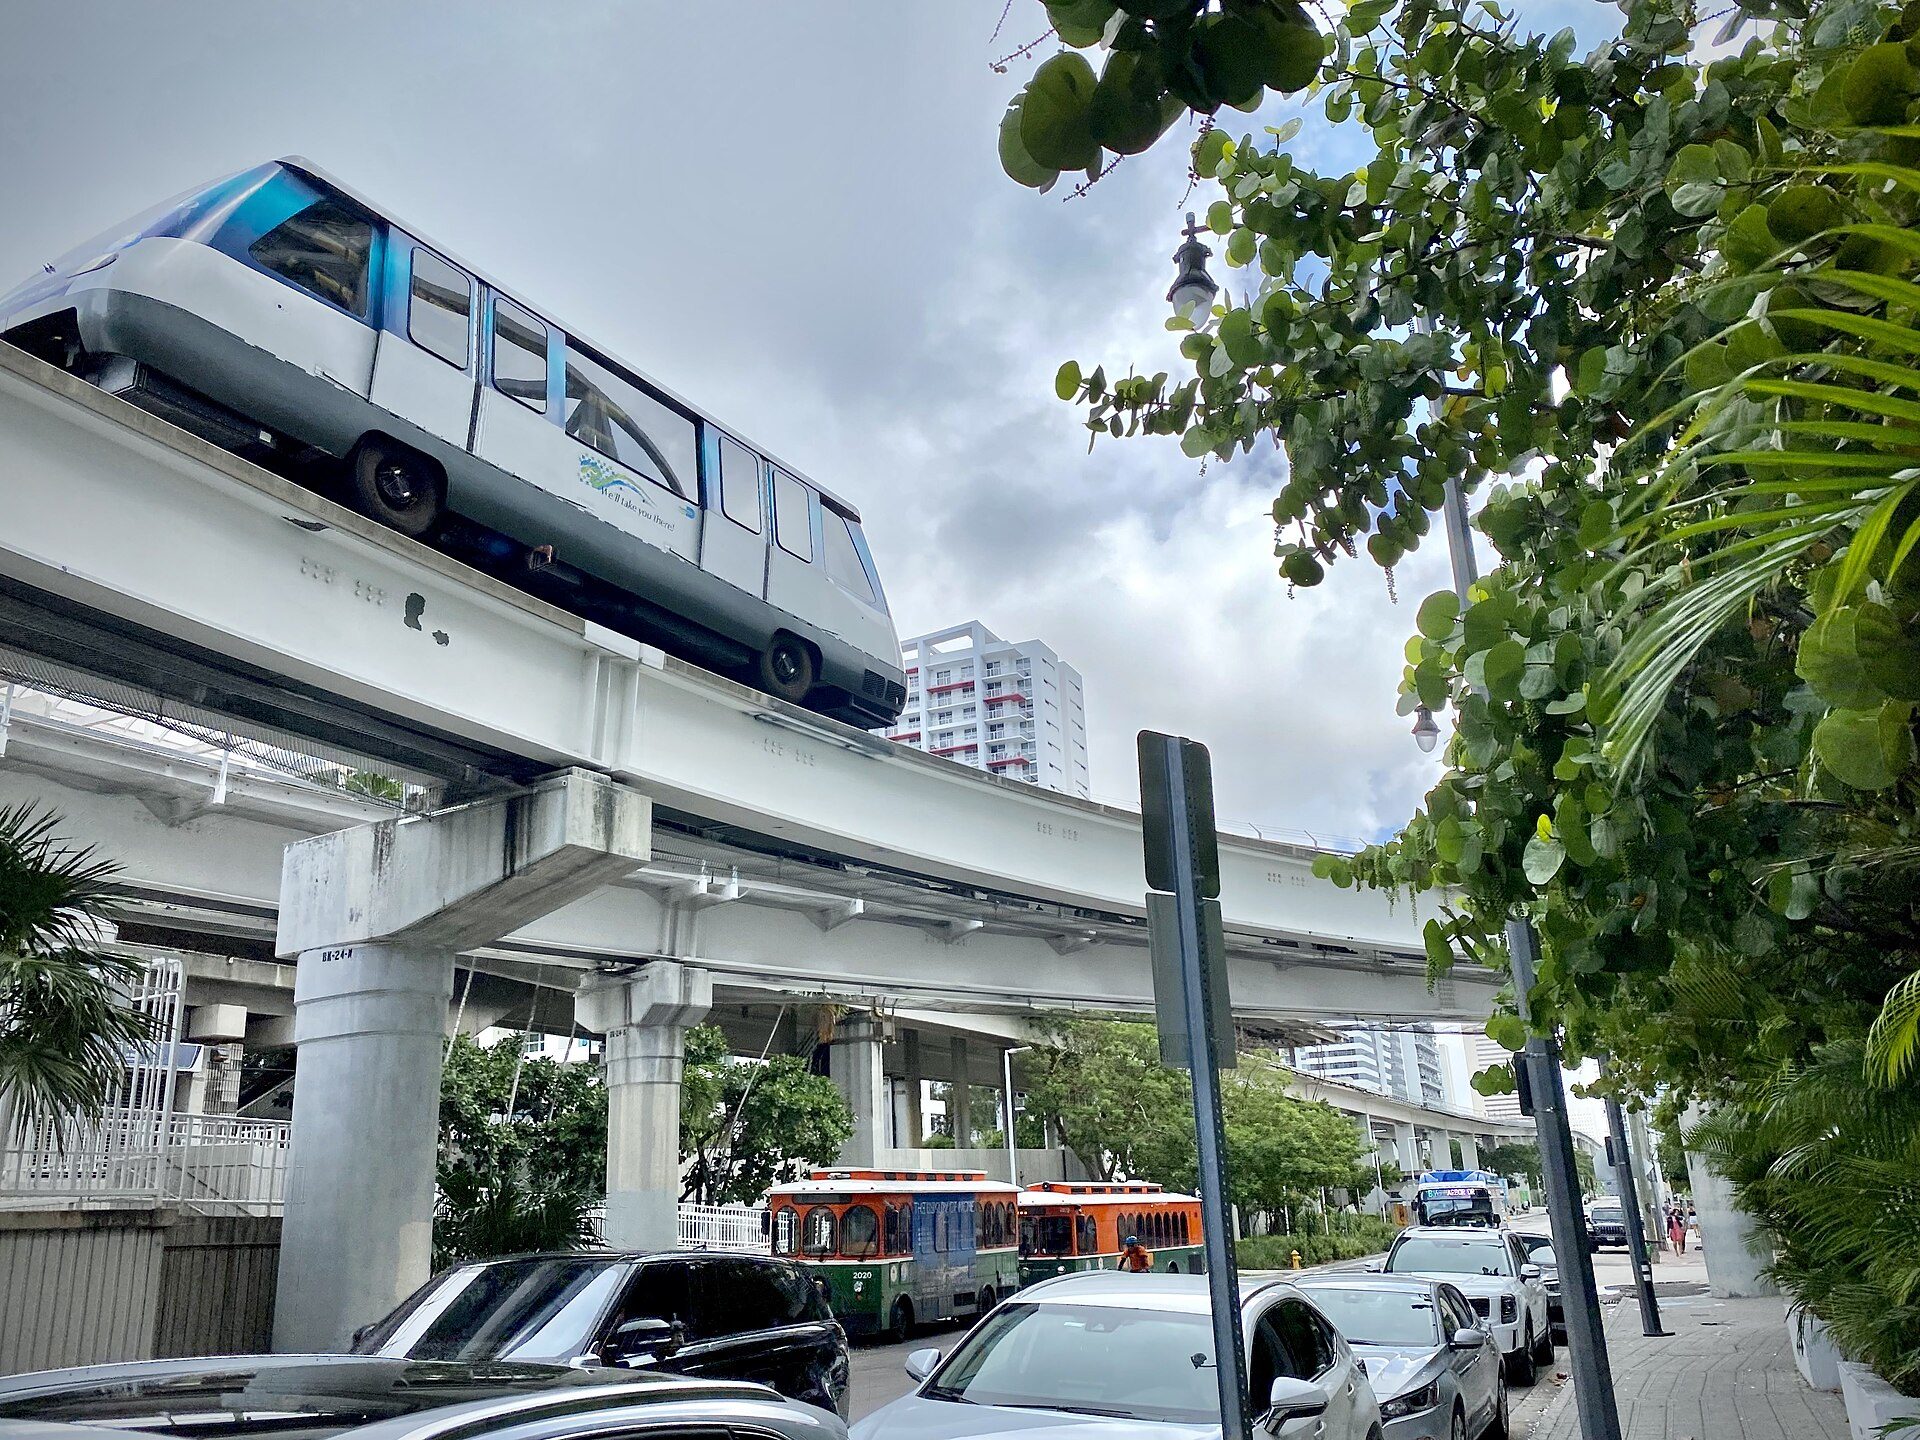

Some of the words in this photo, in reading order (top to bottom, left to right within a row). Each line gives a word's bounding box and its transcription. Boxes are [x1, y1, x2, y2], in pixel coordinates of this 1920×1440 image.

[601, 487, 621, 503] We'll
[621, 498, 638, 512] take
[638, 508, 652, 520] you
[653, 514, 675, 532] there!
[853, 1271, 872, 1279] 2020
